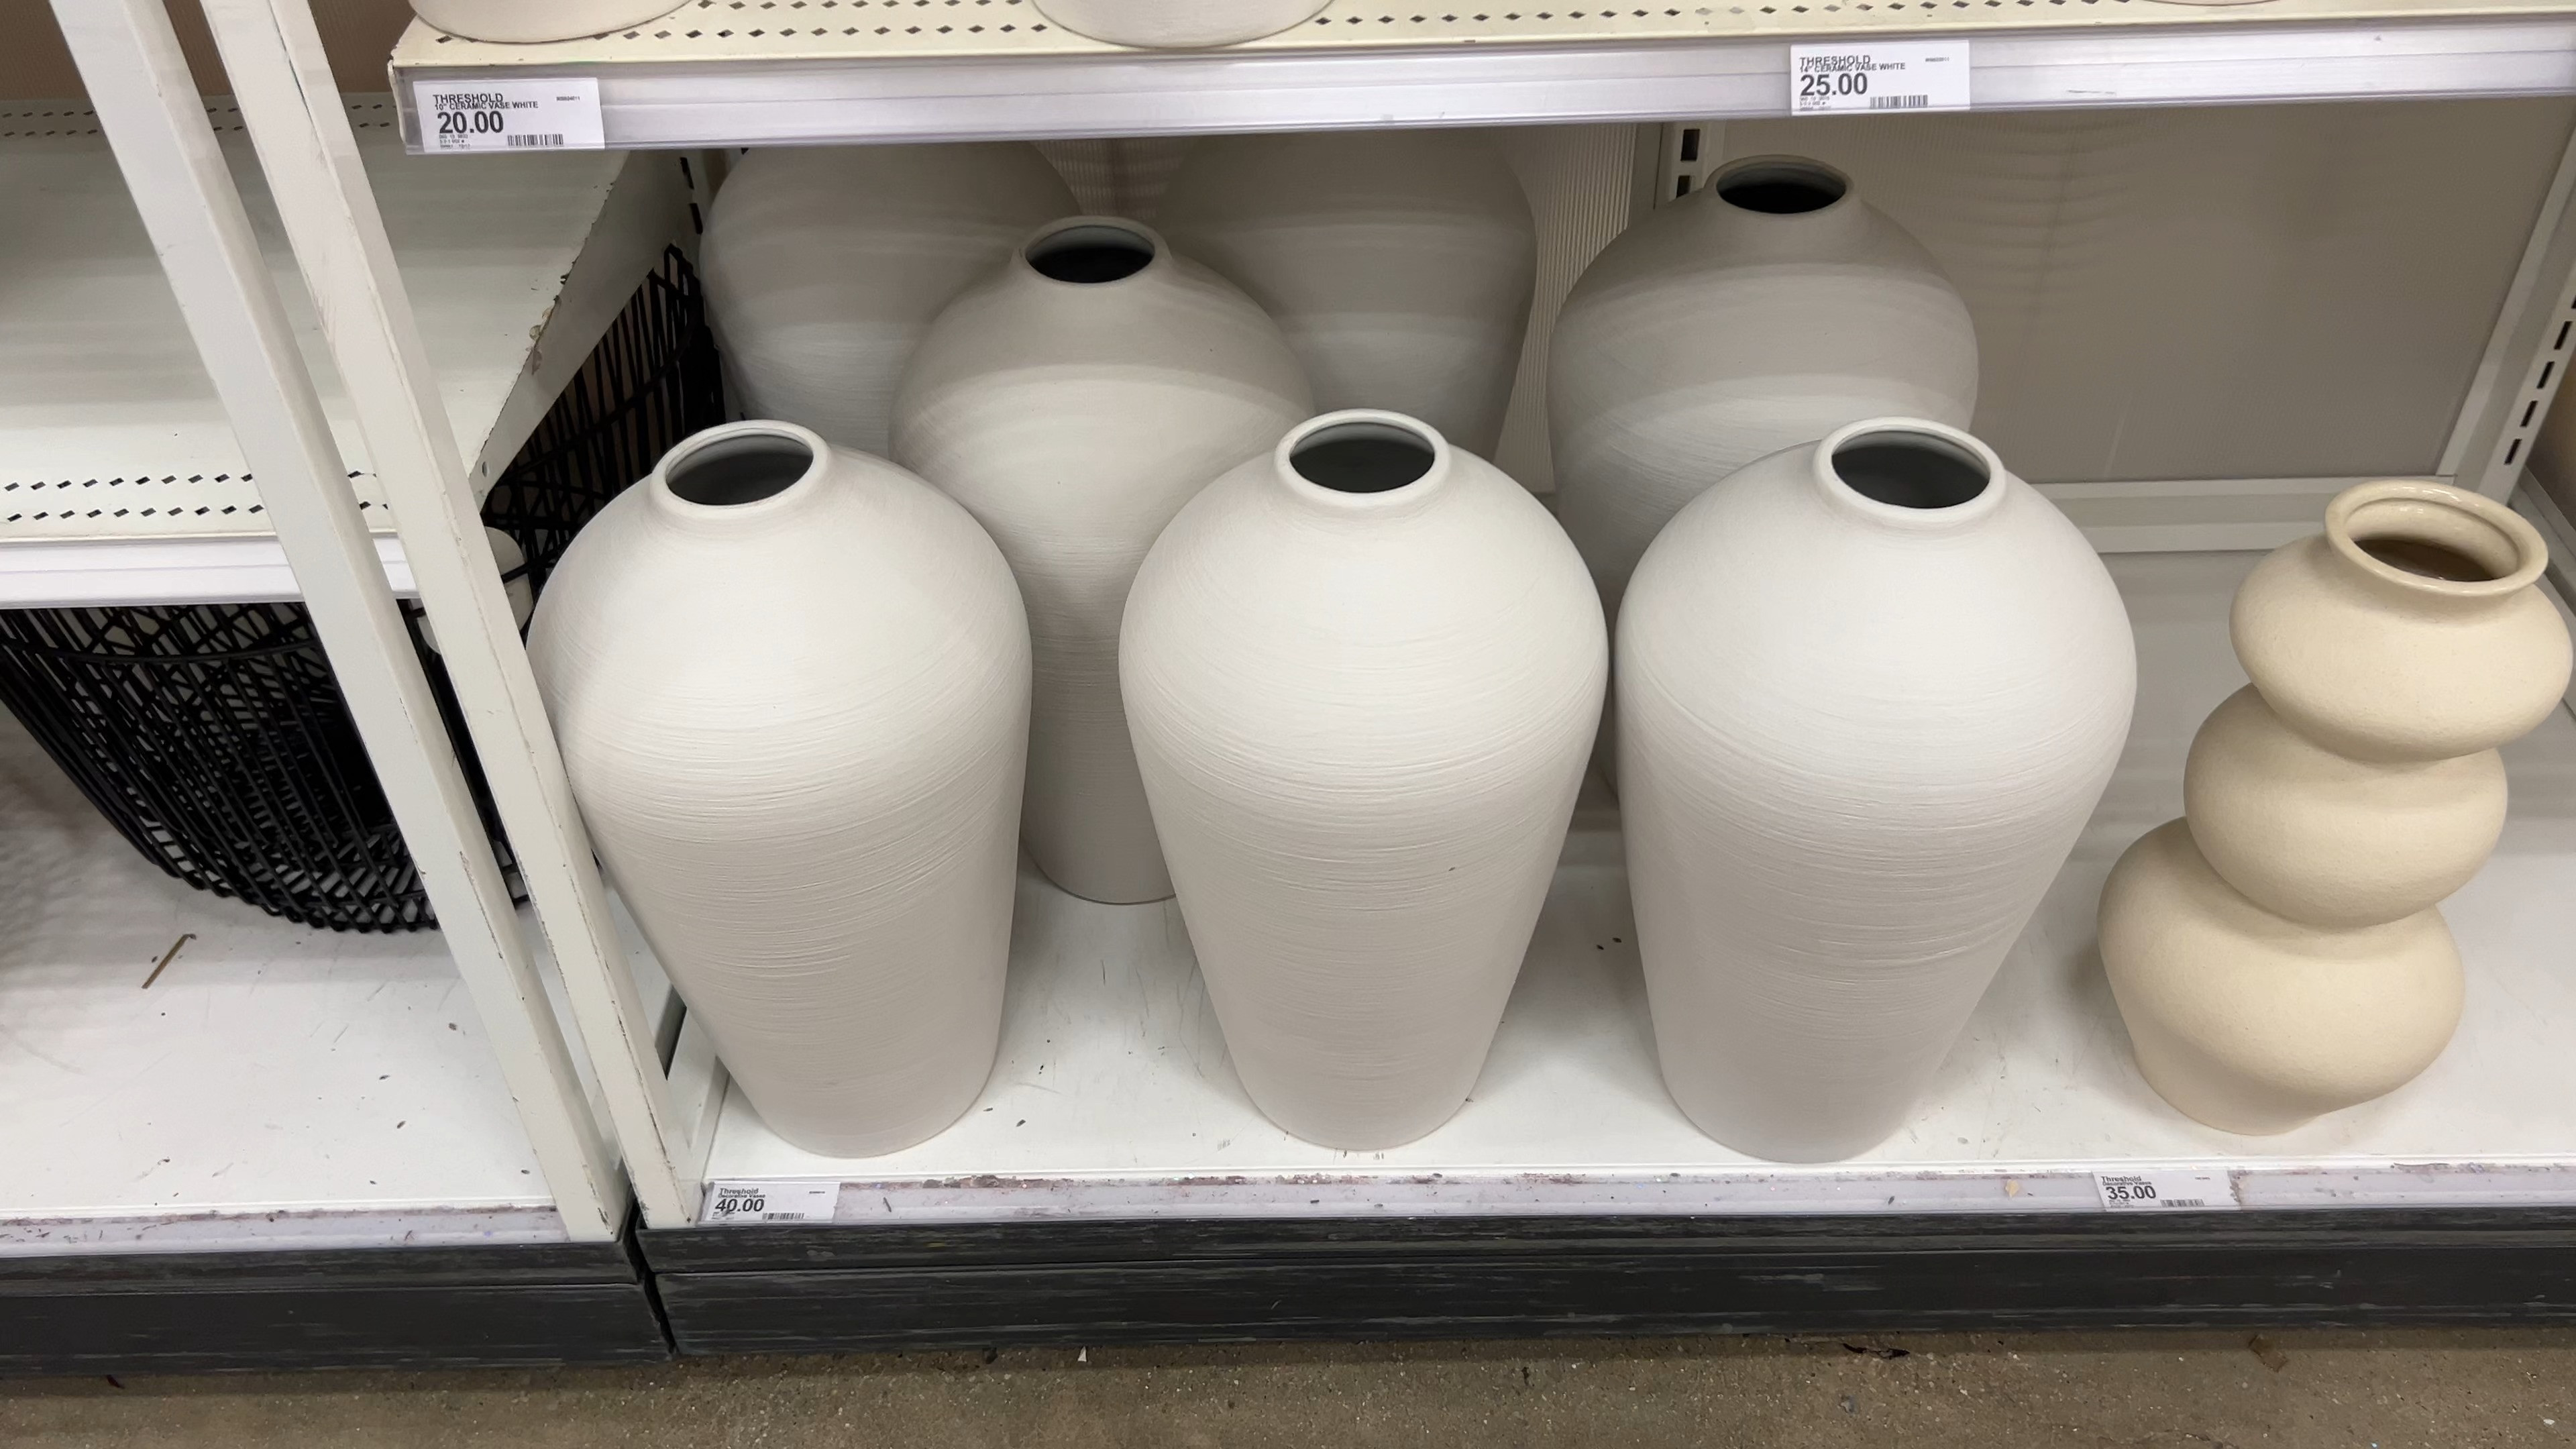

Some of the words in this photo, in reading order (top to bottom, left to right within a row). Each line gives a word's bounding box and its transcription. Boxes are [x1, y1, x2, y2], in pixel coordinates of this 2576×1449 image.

[1799, 55, 1870, 66] THRESHOLD
[1815, 64, 1852, 72] CERAMIC
[1855, 63, 1877, 71] VASE
[1880, 62, 1906, 70] WHITE
[1801, 72, 1868, 96] 25.00
[433, 93, 503, 103] THRESHOLD
[449, 102, 486, 110] CERAMIC
[488, 101, 510, 109] VASE
[437, 111, 504, 133] 20.00
[2106, 1185, 2157, 1199] 35.00
[714, 1198, 765, 1212] 40.00
